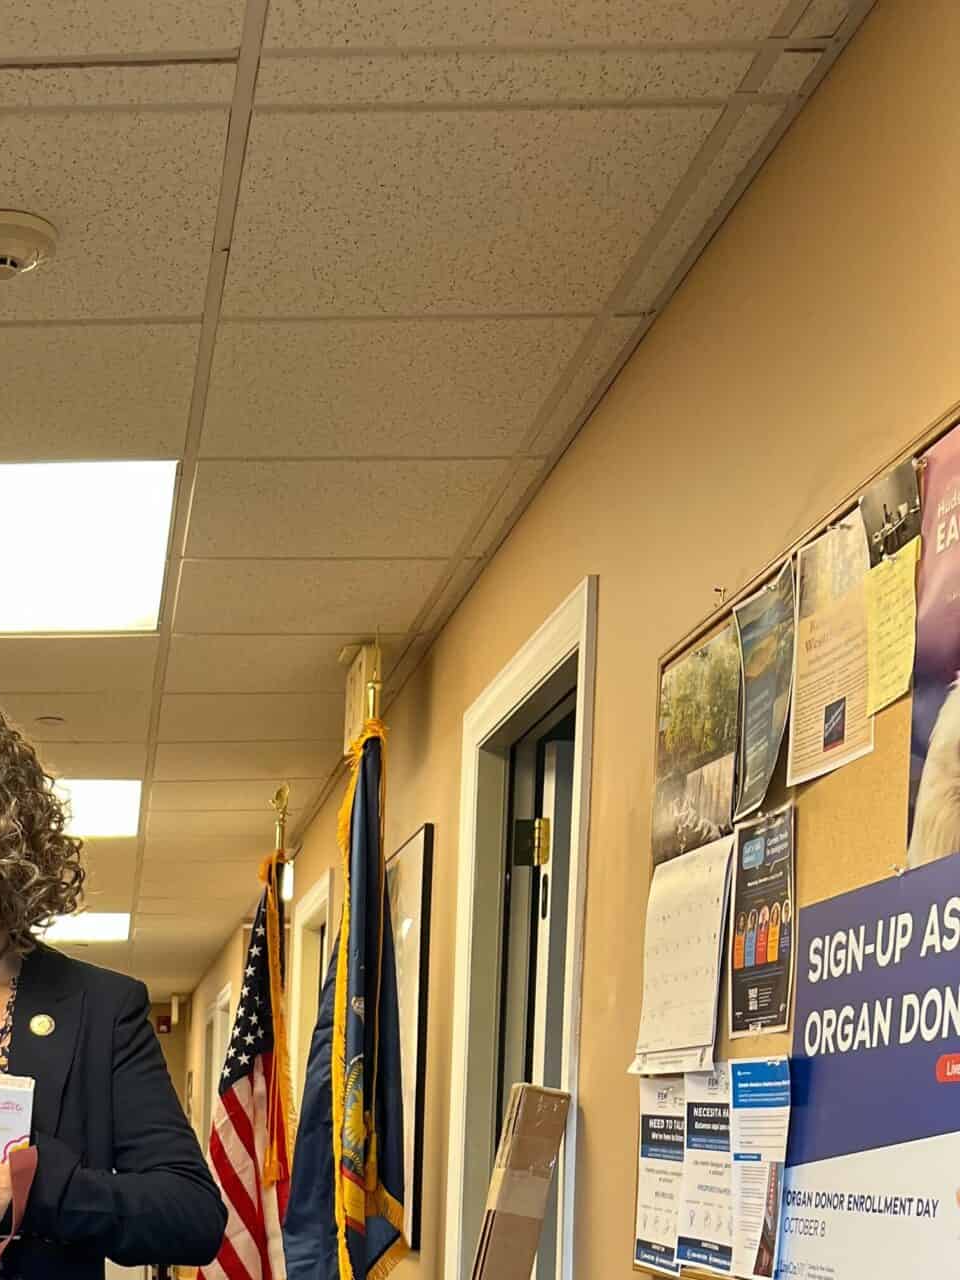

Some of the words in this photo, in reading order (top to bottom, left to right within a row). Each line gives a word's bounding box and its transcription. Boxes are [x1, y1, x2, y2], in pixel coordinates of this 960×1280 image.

[808, 912, 913, 984] SIGN-UP
[919, 896, 960, 957] AS
[804, 997, 893, 1058] ORGAN
[785, 1190, 813, 1208] ORGAN
[815, 1192, 844, 1211] DONOR
[847, 1194, 913, 1216] ENROLLMENT
[916, 1198, 939, 1218] DAY
[784, 1217, 818, 1237] OCTOBER
[820, 1221, 826, 1238] 8
